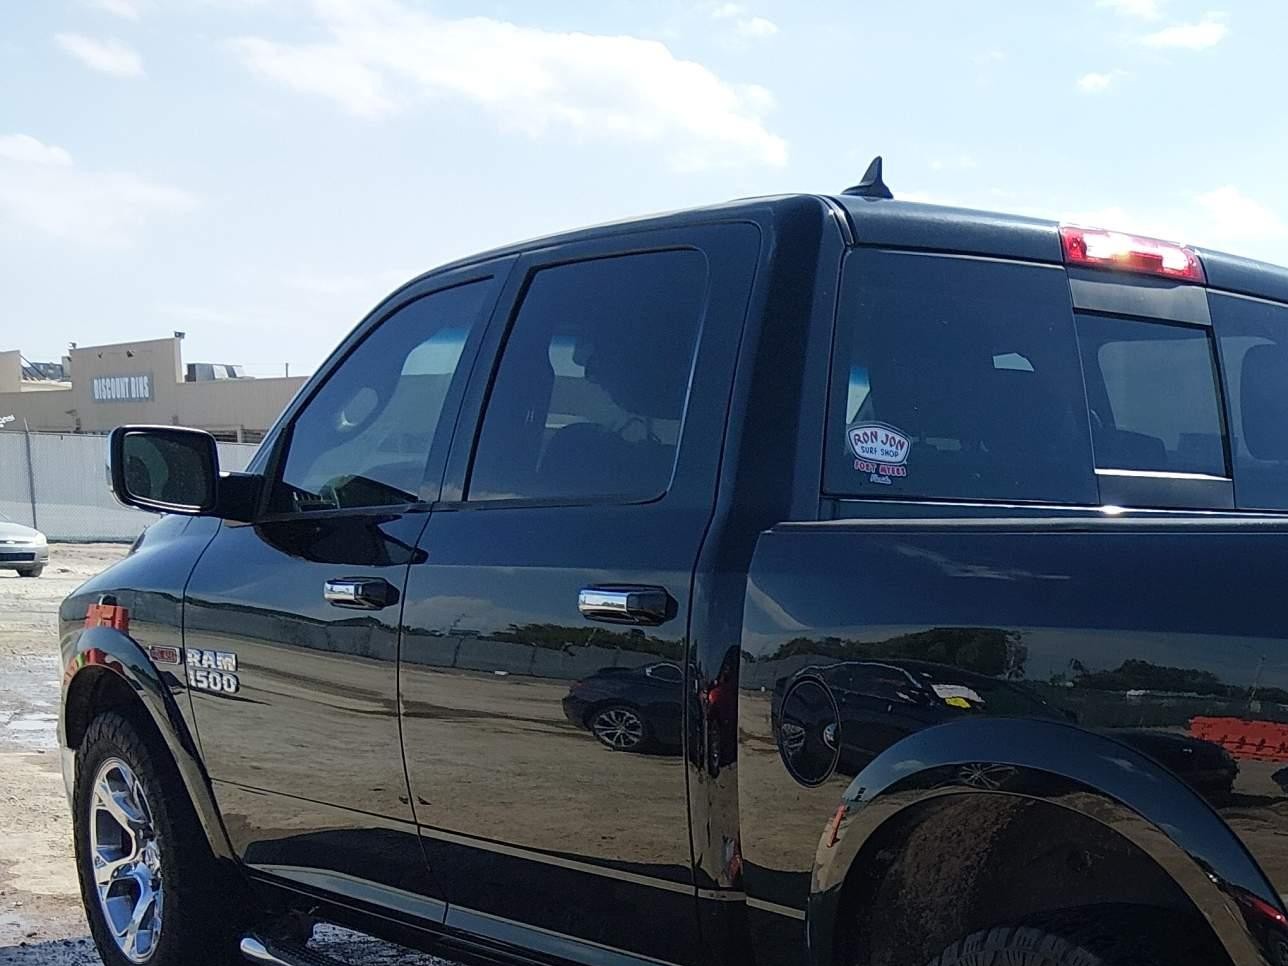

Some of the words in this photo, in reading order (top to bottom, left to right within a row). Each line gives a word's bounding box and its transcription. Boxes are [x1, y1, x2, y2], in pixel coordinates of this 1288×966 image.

[93, 377, 129, 400] DISCOUNT
[853, 430, 878, 446] RON
[881, 434, 906, 451] JON
[860, 446, 878, 456] SURF
[880, 448, 899, 458] SHOP
[854, 459, 878, 473] FORT
[187, 648, 237, 671] RAM
[189, 669, 238, 693] 1500
